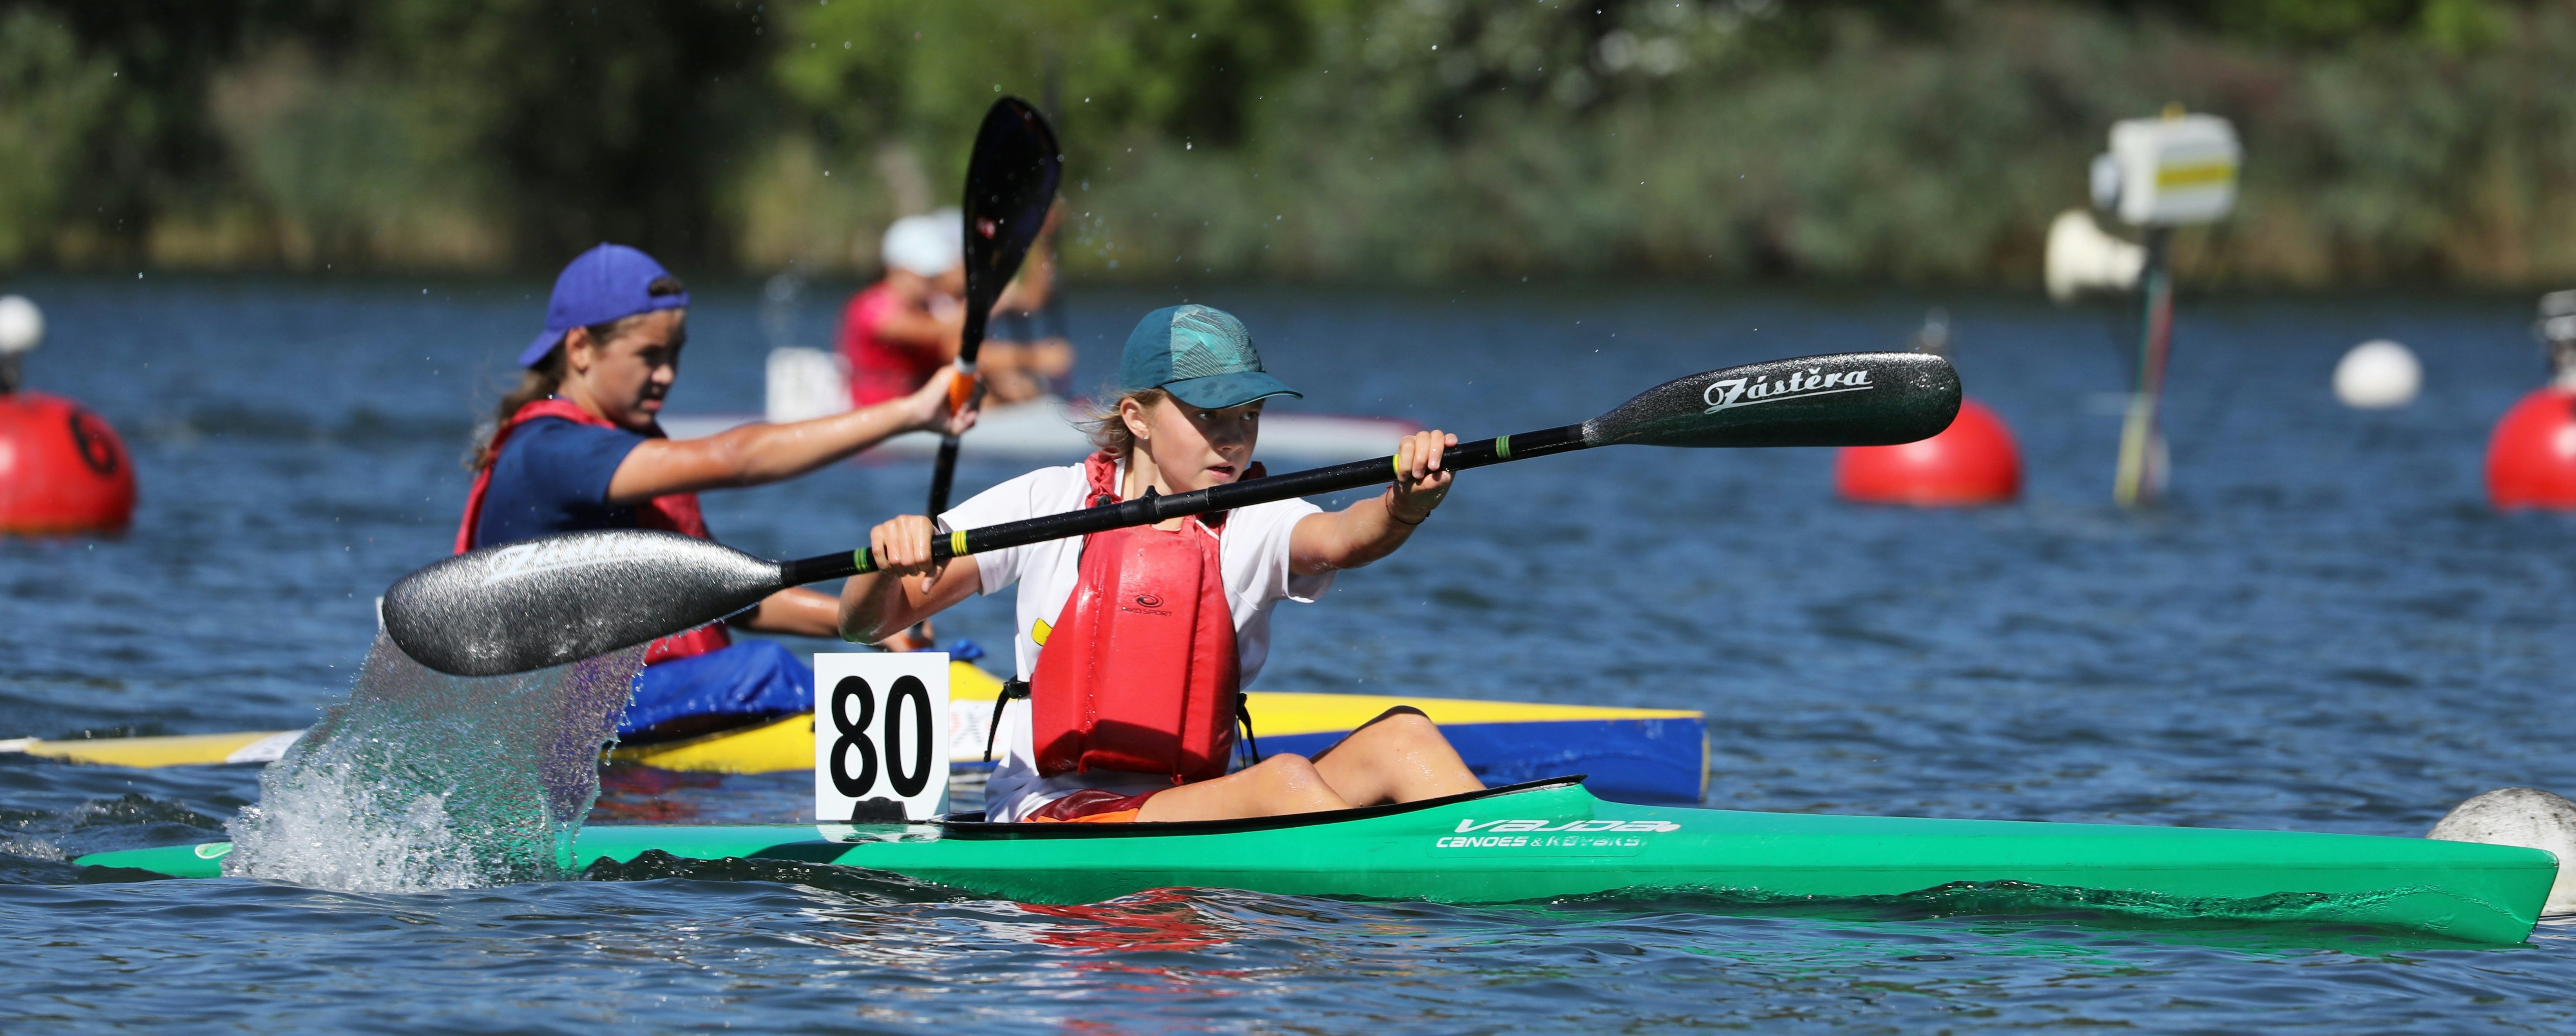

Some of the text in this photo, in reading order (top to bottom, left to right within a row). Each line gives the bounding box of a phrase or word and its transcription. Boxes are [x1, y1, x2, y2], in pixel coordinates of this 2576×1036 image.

[1703, 367, 1874, 414] Zástěra
[830, 675, 932, 797] 80
[1530, 838, 1543, 846] &
